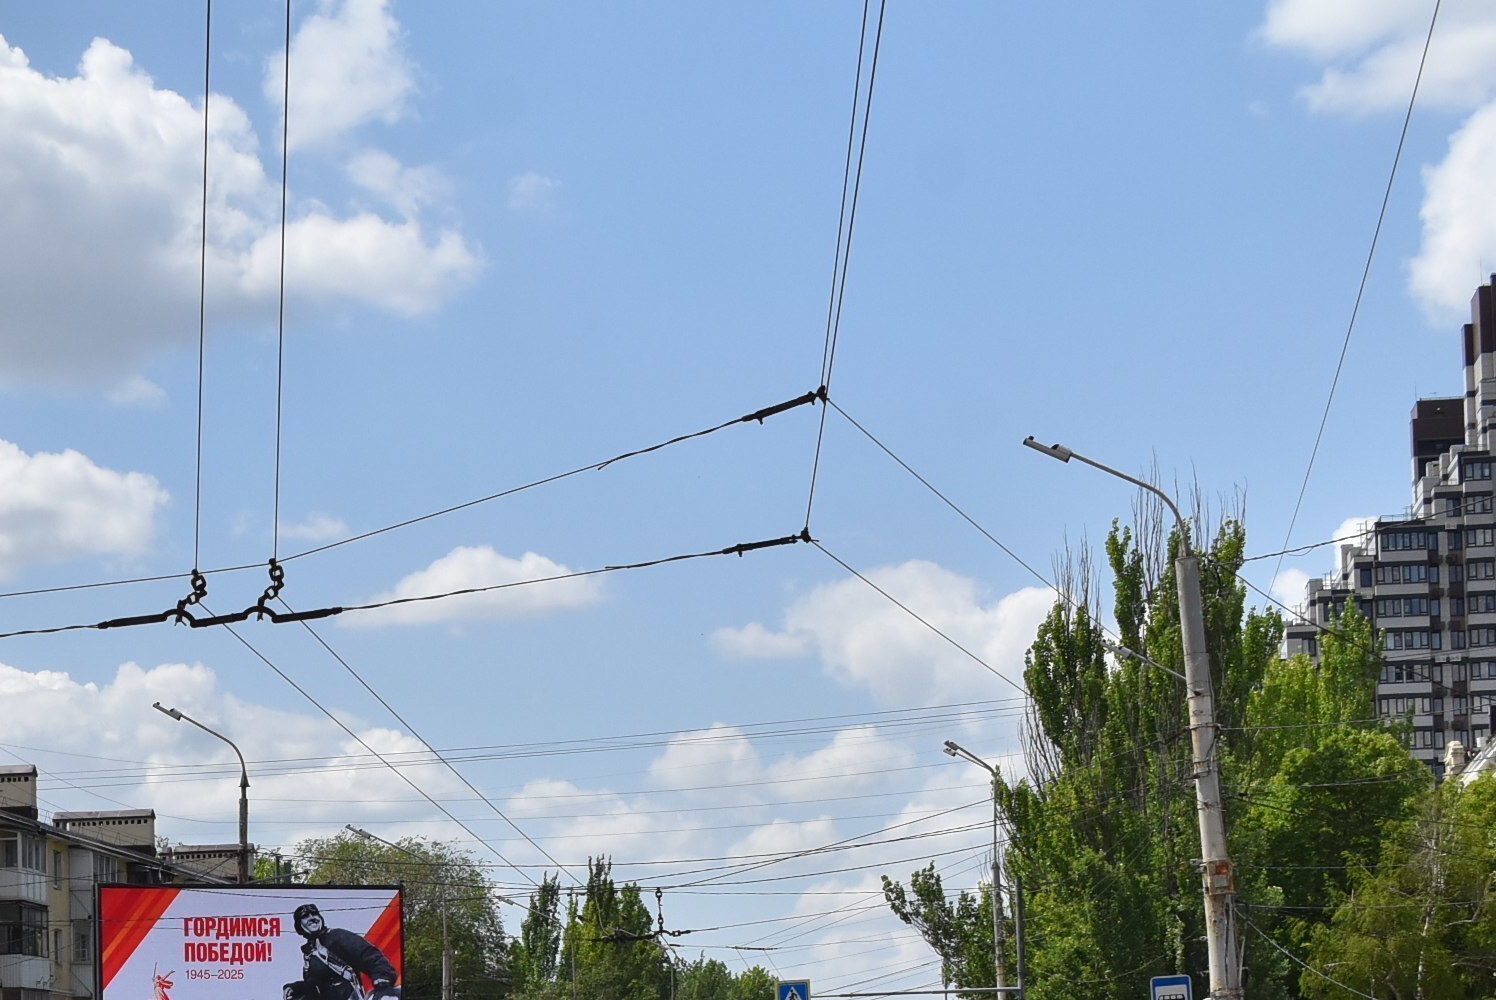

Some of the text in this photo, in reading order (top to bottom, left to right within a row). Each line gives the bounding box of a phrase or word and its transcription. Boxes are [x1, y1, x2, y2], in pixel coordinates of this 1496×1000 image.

[184, 917, 281, 940] ГОРДИМСЯ
[184, 940, 273, 965] ПОБЕДОЙ!
[185, 969, 245, 980] 1945–2025
